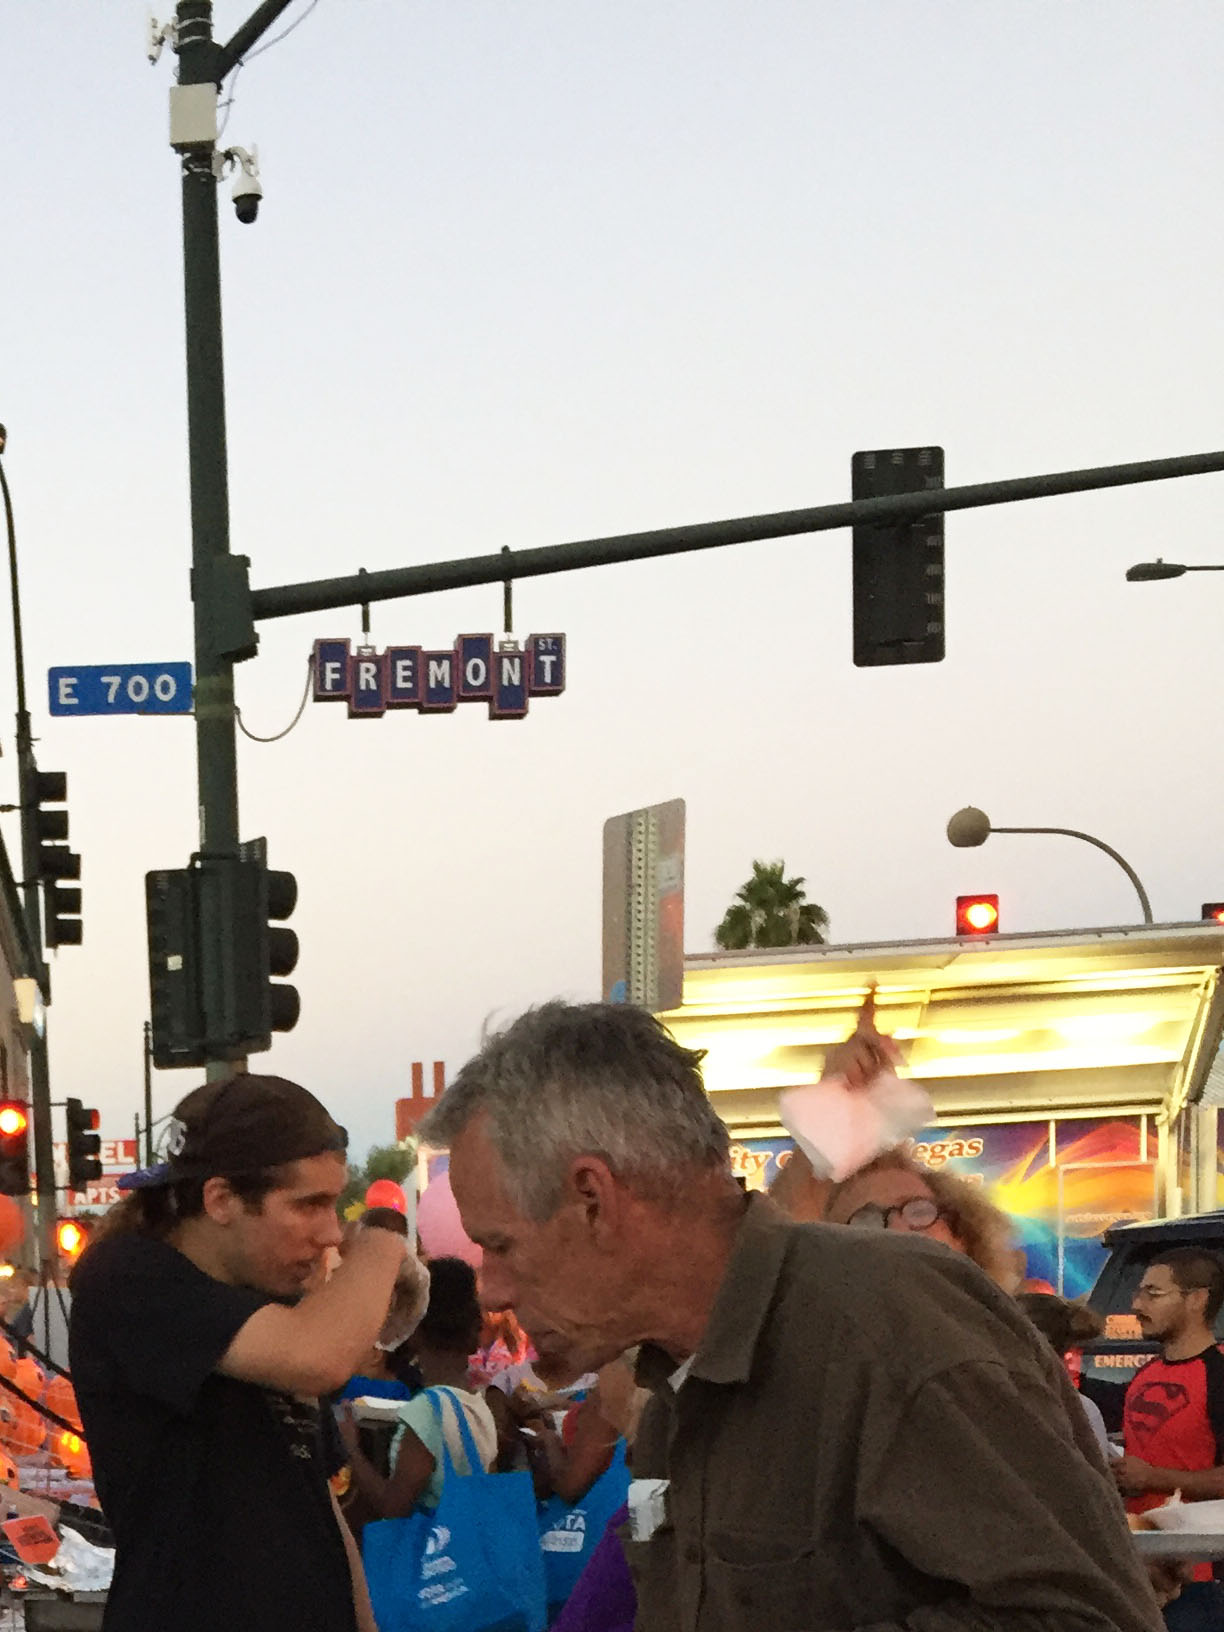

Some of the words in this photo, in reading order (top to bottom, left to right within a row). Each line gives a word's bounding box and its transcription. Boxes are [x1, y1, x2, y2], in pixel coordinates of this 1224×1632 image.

[58, 678, 79, 705] E
[100, 673, 177, 703] 700
[324, 654, 557, 691] FREMONT
[730, 1147, 773, 1175] ity
[908, 1137, 984, 1168] egas
[74, 1187, 121, 1204] APTS
